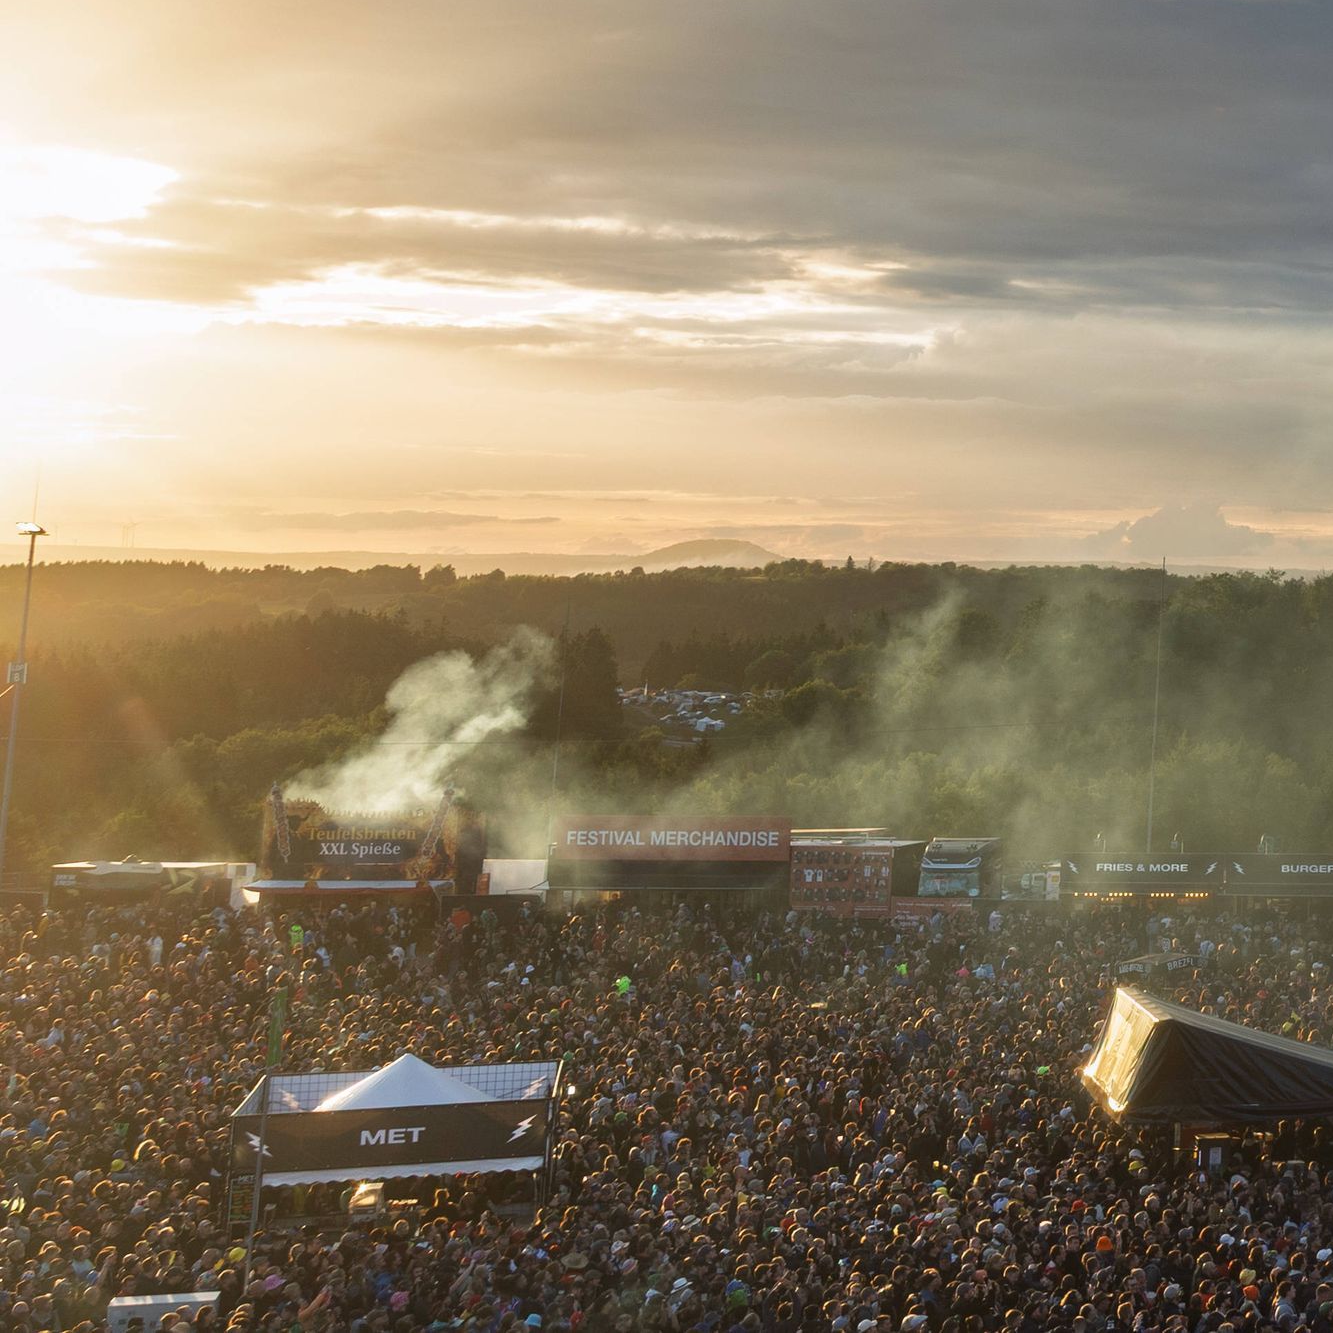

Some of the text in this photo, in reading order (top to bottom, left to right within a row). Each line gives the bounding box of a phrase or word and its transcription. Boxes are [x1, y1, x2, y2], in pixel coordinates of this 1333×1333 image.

[308, 827, 417, 841] Teufelsbraten
[566, 830, 779, 847] FESTIVAL MERCHANDISE
[319, 842, 401, 858] XXL Spieße
[1096, 863, 1189, 872] FRIES & MORE
[360, 1127, 426, 1146] MET
